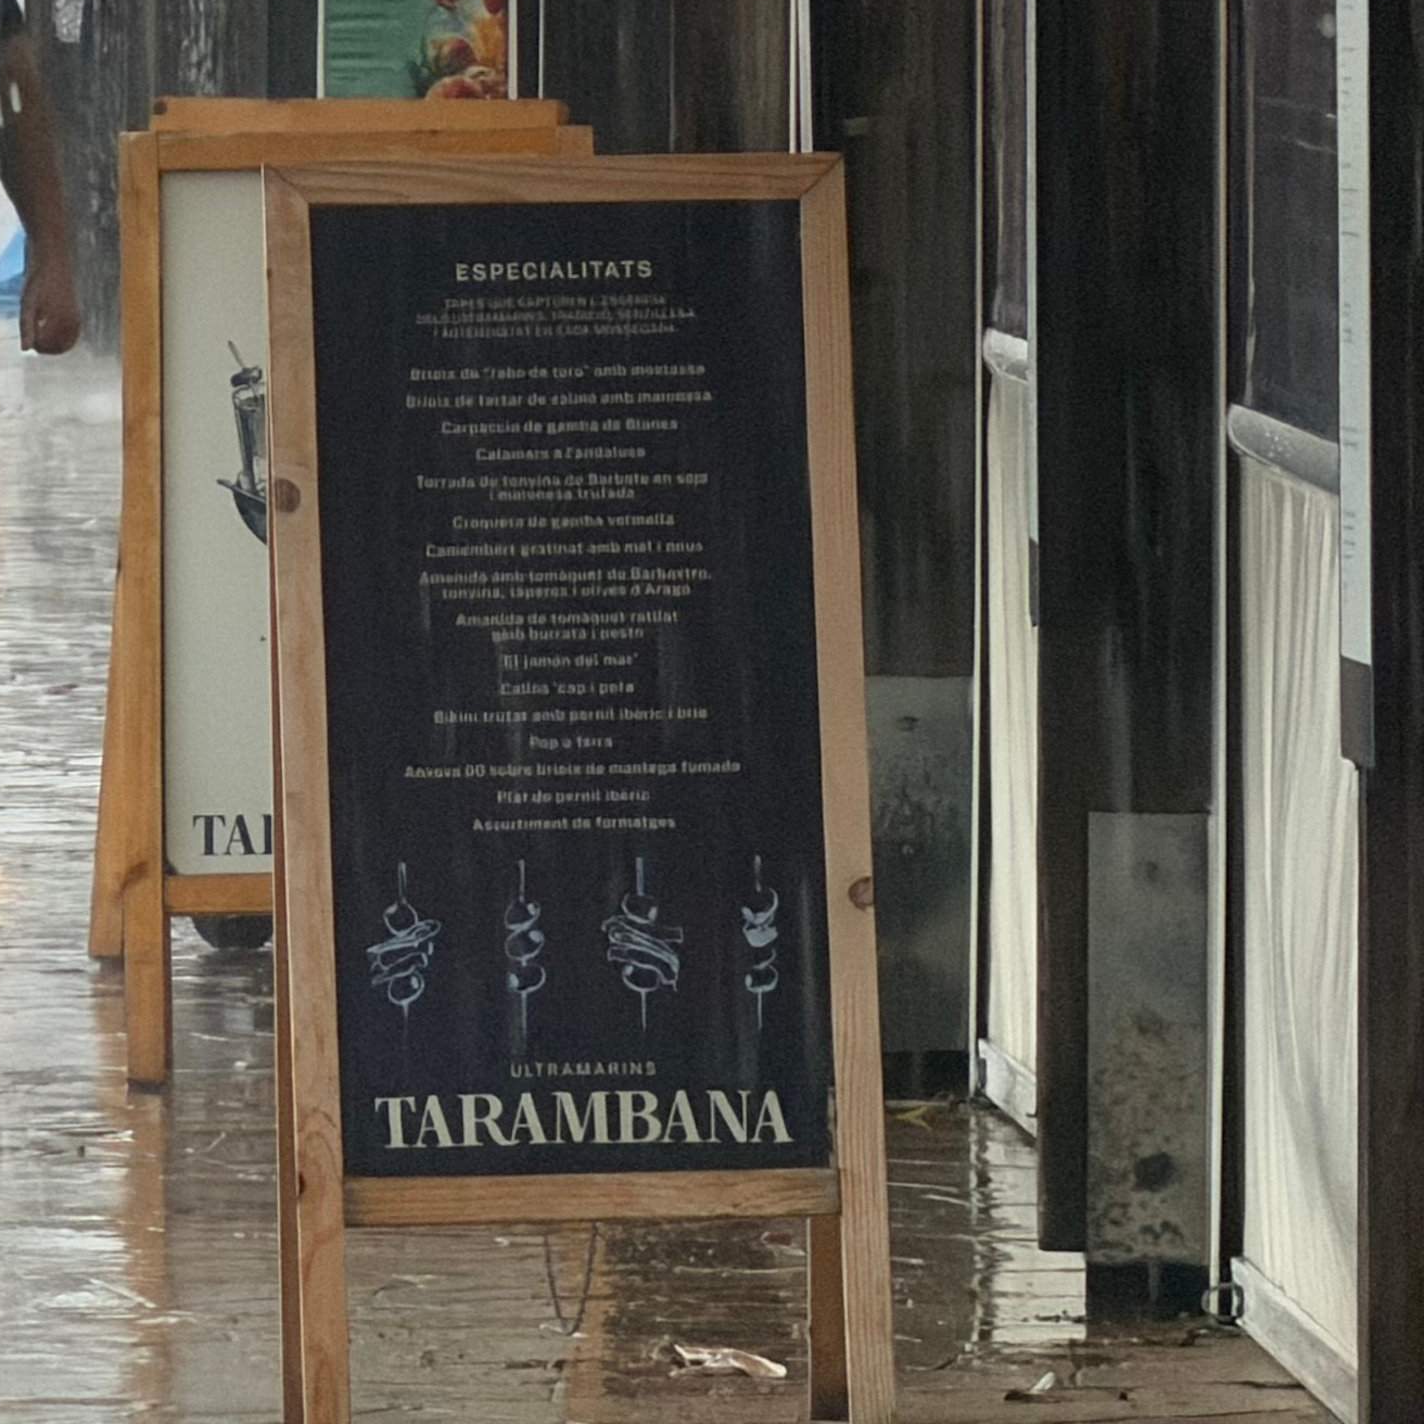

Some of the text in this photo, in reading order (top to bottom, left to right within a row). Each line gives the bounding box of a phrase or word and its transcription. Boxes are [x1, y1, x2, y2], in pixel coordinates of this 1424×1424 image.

[456, 260, 653, 282] ESPECIALITATS
[510, 1061, 657, 1077] ULTRAMARINS
[374, 1089, 795, 1149] TARAMBANA
